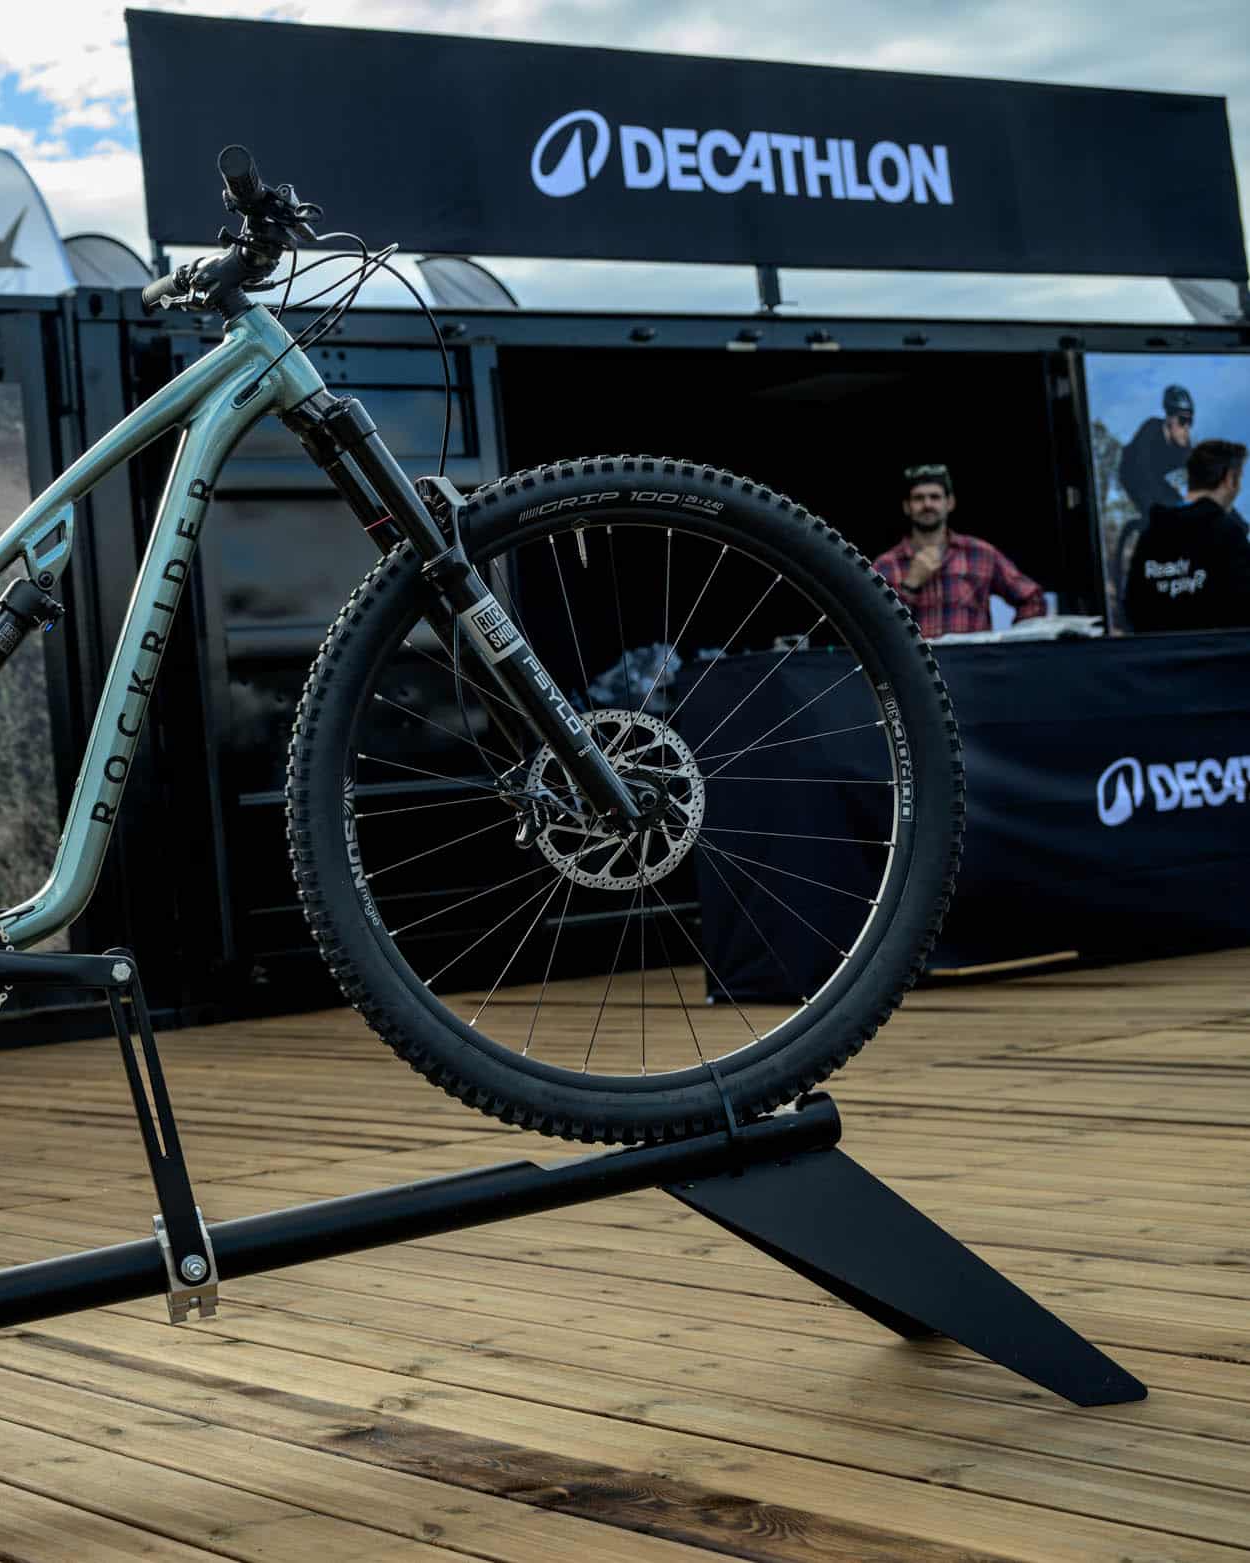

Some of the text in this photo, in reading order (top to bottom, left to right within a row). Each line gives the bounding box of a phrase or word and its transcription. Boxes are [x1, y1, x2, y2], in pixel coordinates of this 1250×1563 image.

[619, 125, 954, 205] DECATHLON
[538, 490, 620, 514] GRIP
[630, 490, 679, 504] 100
[90, 477, 214, 826] ROCKRIDER
[476, 602, 507, 632] ROC
[488, 617, 519, 650] SHO
[523, 655, 582, 735] PSYLO
[344, 819, 367, 889] SUN
